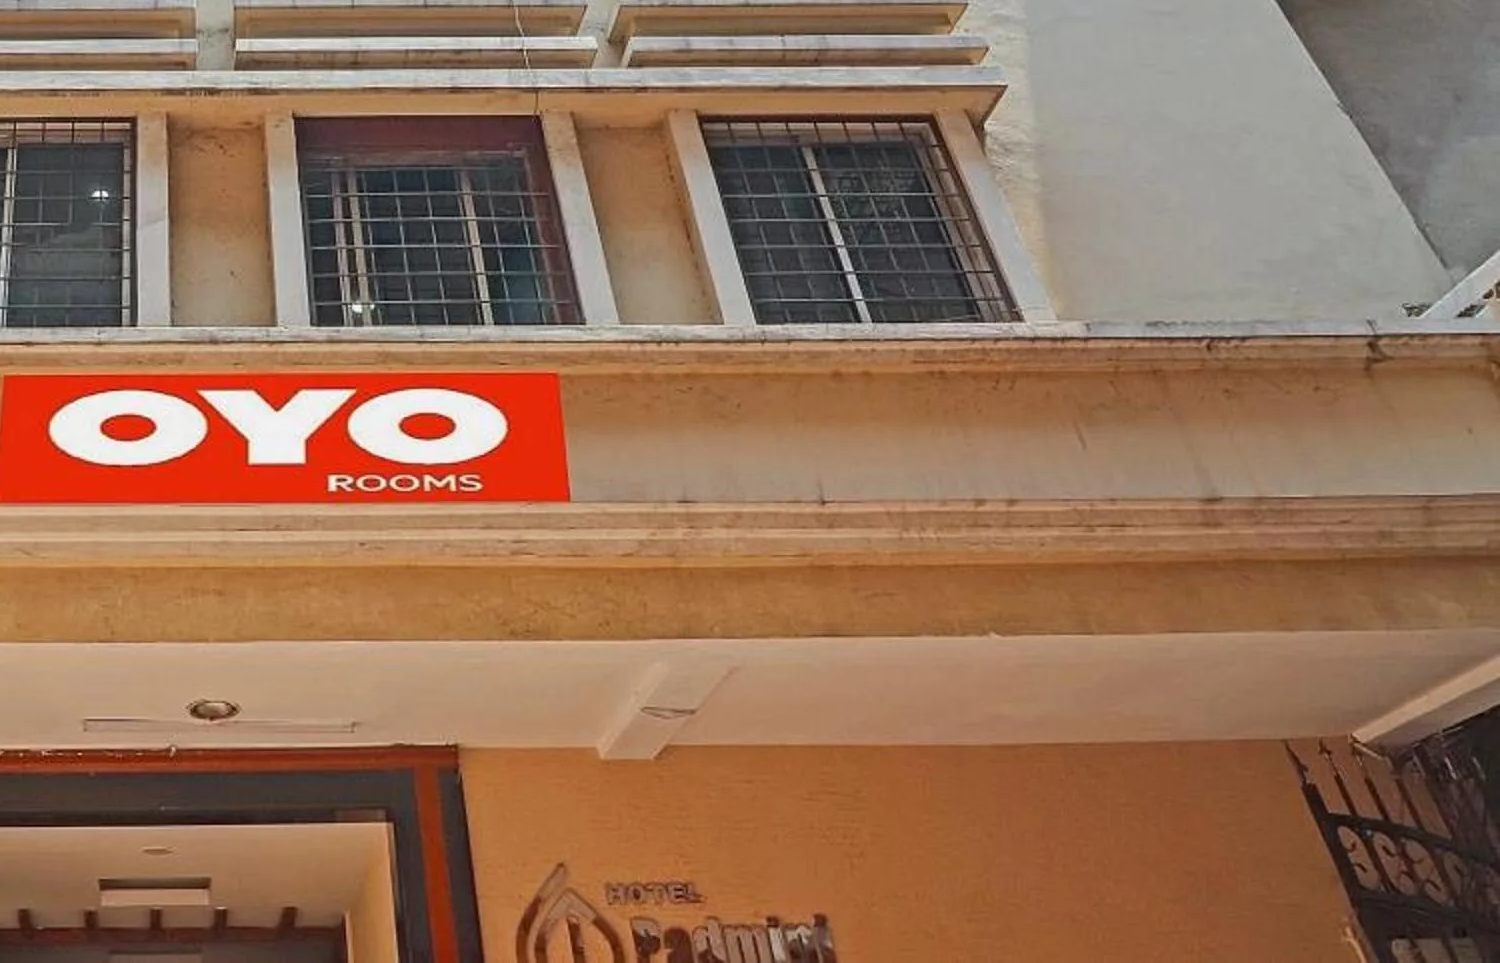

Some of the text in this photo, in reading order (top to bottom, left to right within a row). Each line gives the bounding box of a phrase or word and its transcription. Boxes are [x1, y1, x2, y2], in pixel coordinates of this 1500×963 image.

[48, 388, 508, 467] OYO
[326, 474, 483, 493] ROOMS
[606, 882, 704, 905] HOTEL
